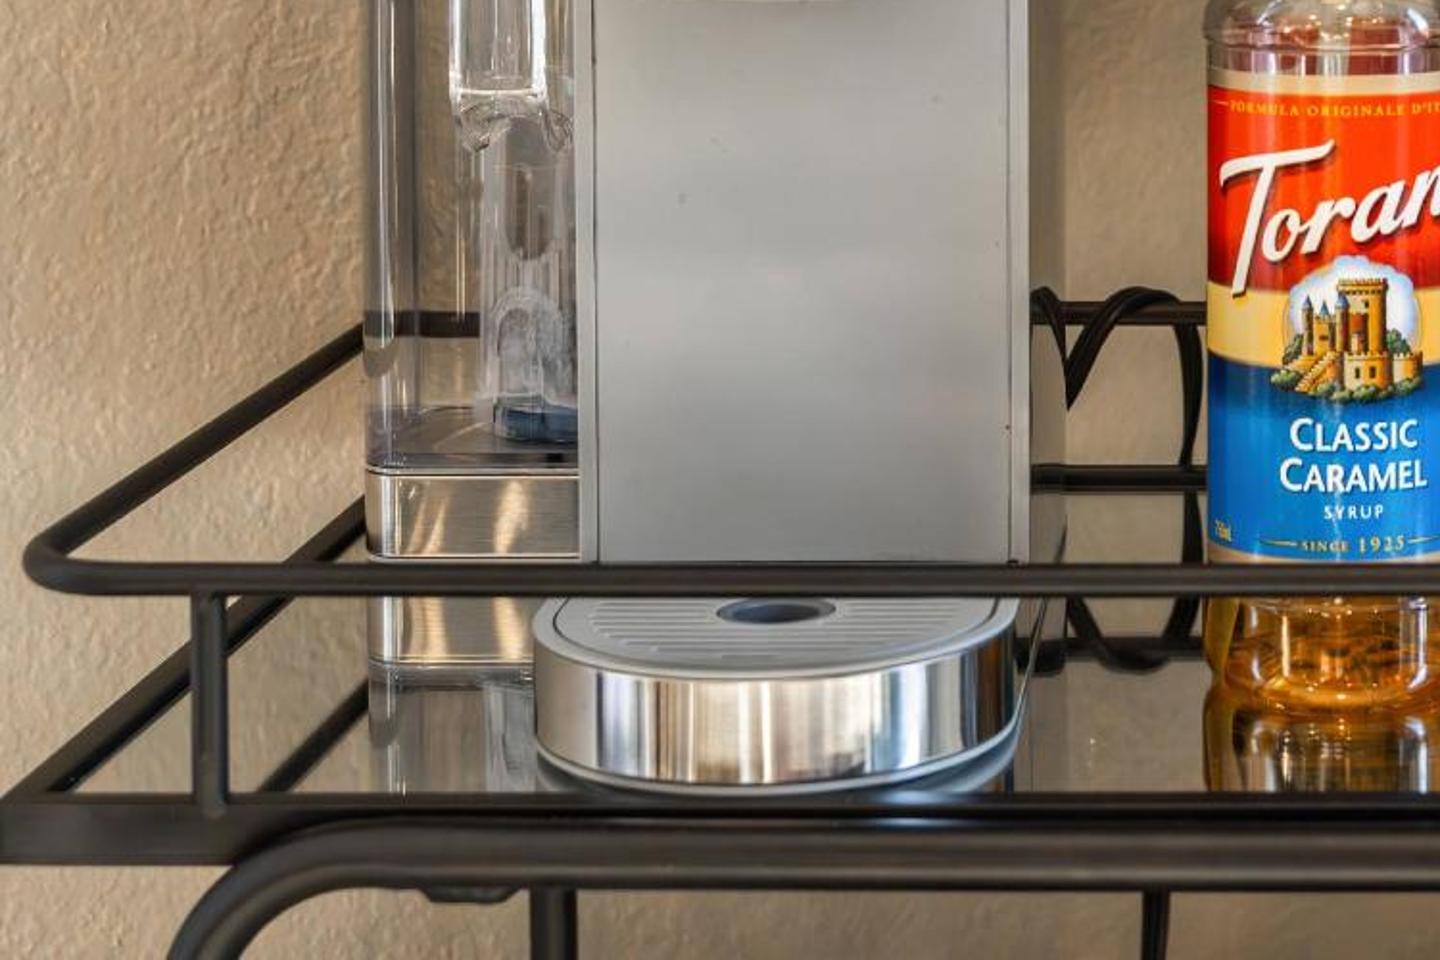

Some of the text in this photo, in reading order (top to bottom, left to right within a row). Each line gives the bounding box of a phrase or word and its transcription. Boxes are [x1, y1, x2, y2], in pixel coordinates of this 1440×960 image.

[1307, 103, 1404, 116] ORIGINALE
[1289, 417, 1419, 452] CLASSIC
[1279, 457, 1428, 493] CARAMEL
[1323, 506, 1384, 520] SYRUP
[1303, 536, 1405, 553] SINCE 1925
